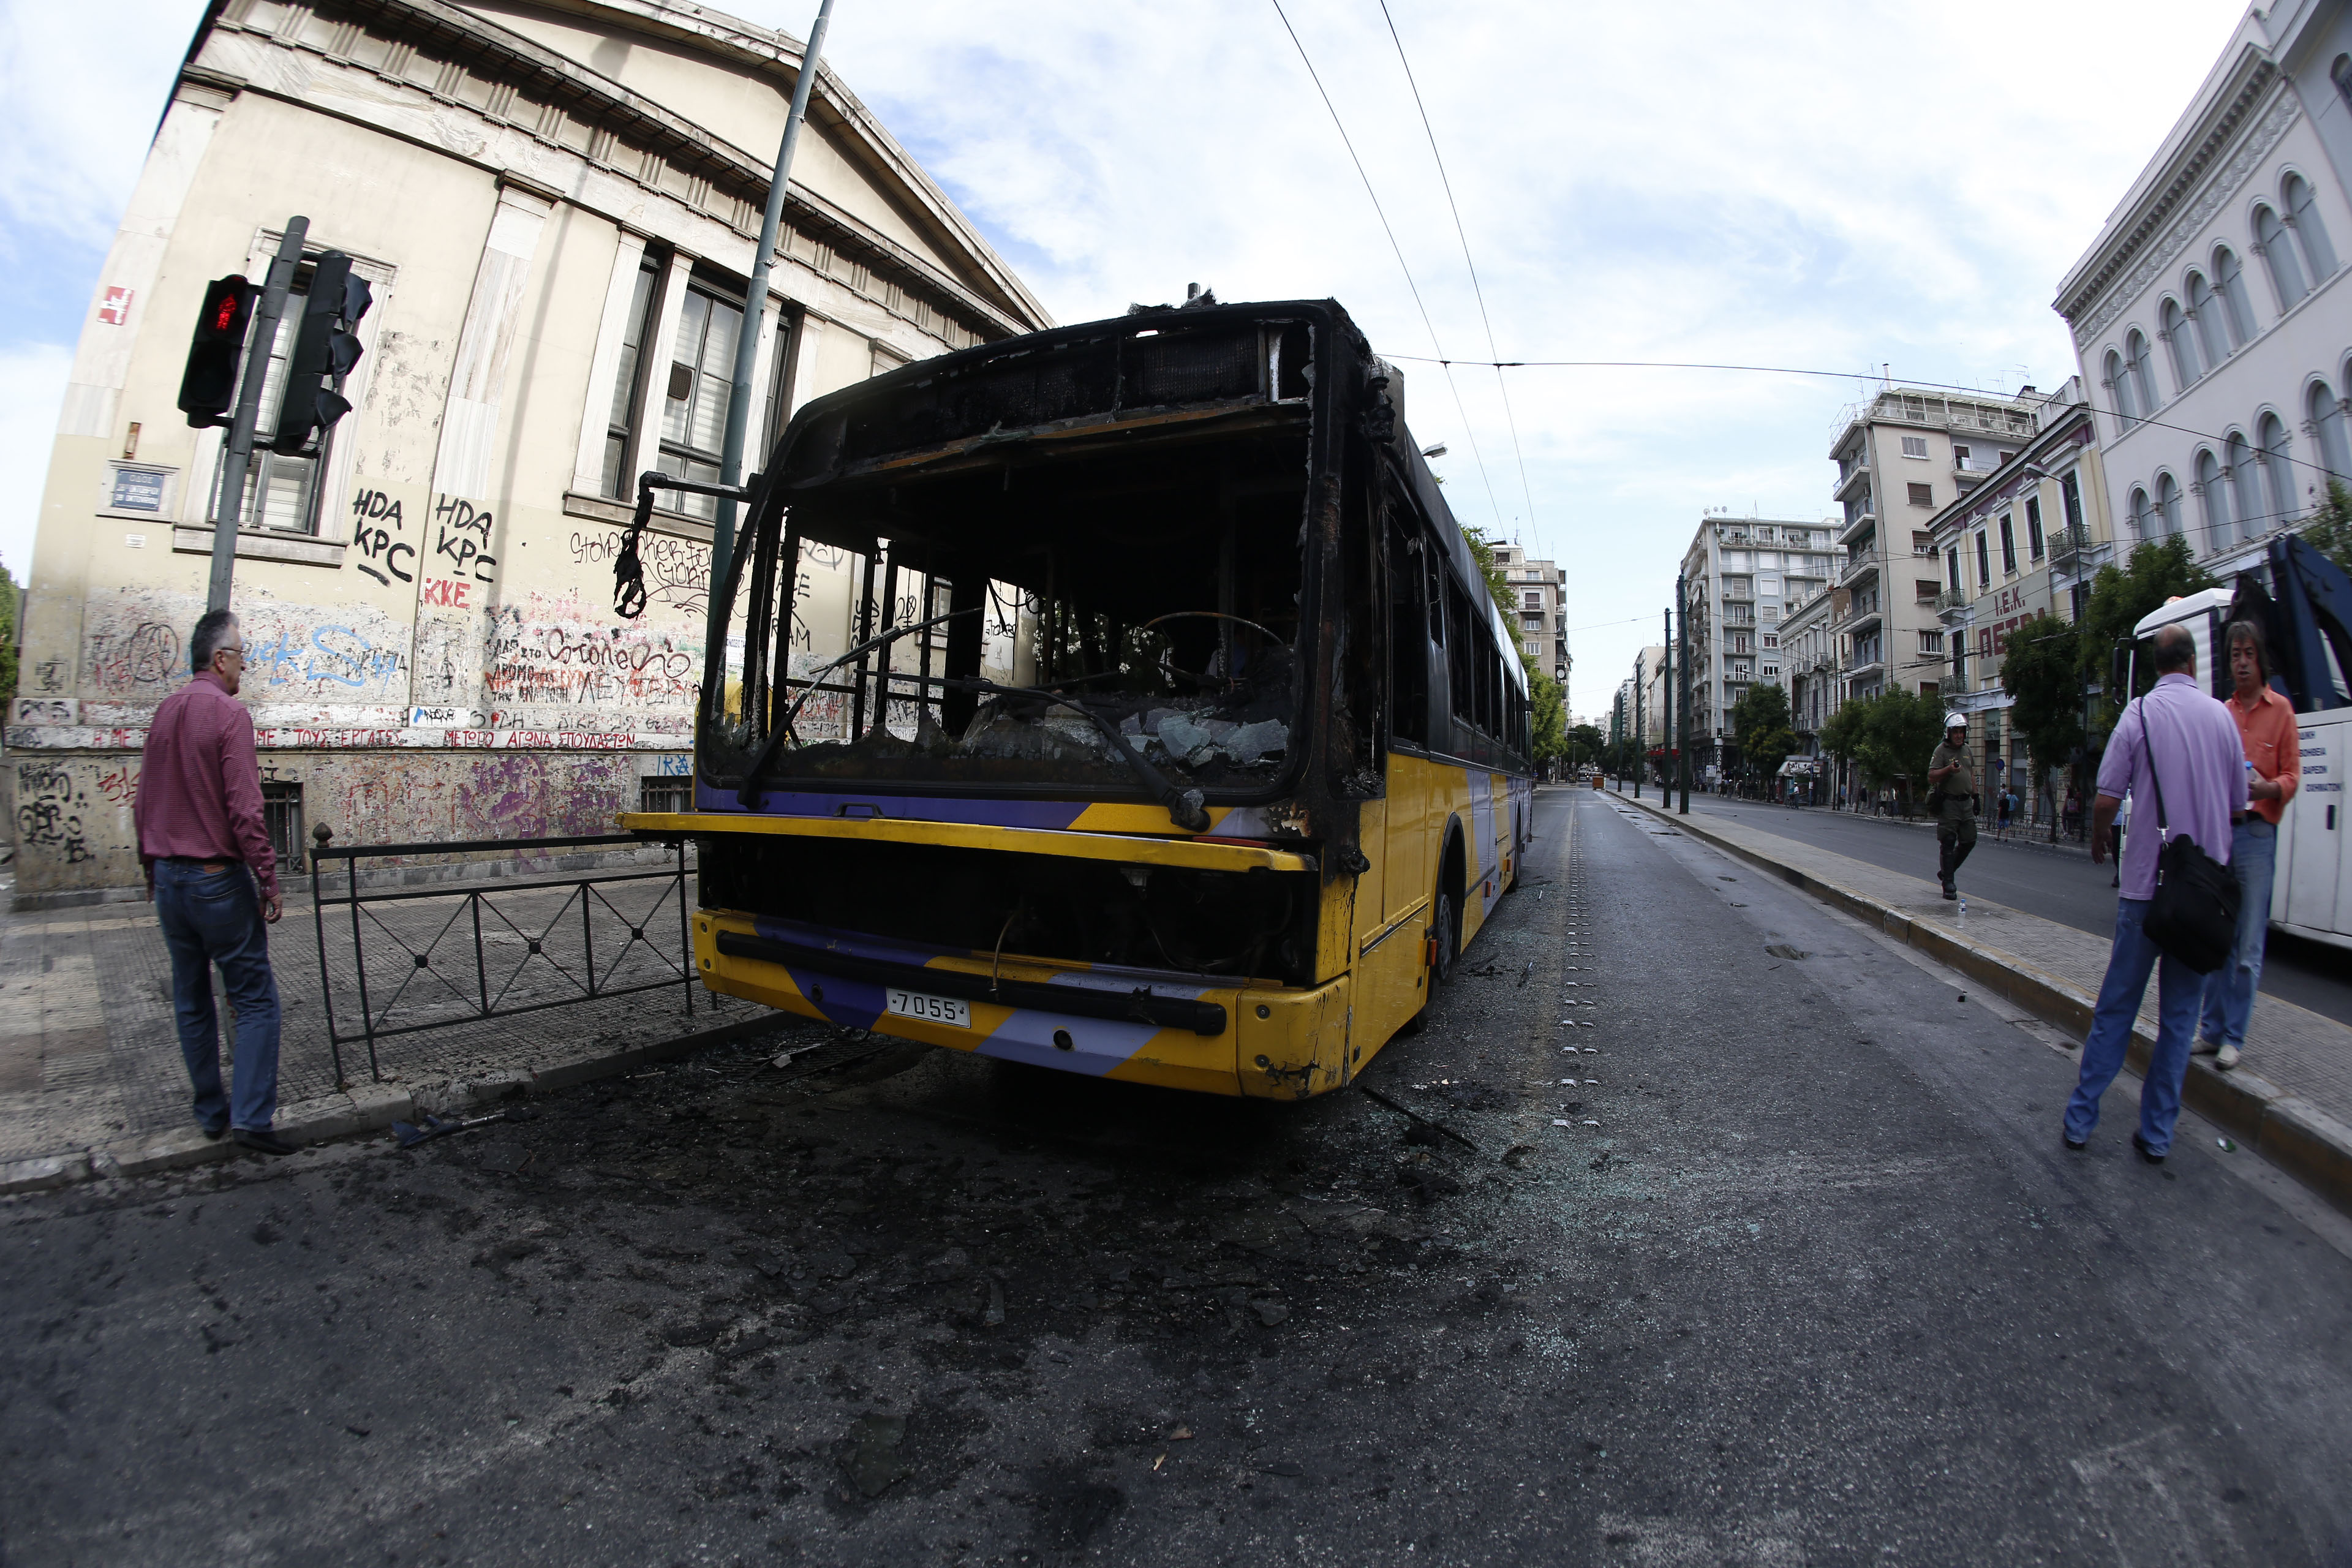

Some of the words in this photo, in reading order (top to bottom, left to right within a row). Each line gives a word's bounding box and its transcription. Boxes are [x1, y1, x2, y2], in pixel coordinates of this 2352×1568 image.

[129, 474, 153, 484] ΟΔΟΣ
[353, 488, 402, 530] HDA
[435, 492, 493, 550] HDA
[424, 578, 471, 609] ΚΚΕ
[293, 728, 329, 747] ΤΟΥΣ
[341, 729, 404, 747] ΕΡΓΑΤΕΣ
[507, 731, 551, 748] ΑΓΩΝΑ
[559, 732, 636, 748] ΣΠΟΥΔΑΣΤΩΝ
[897, 993, 956, 1020] 7055
